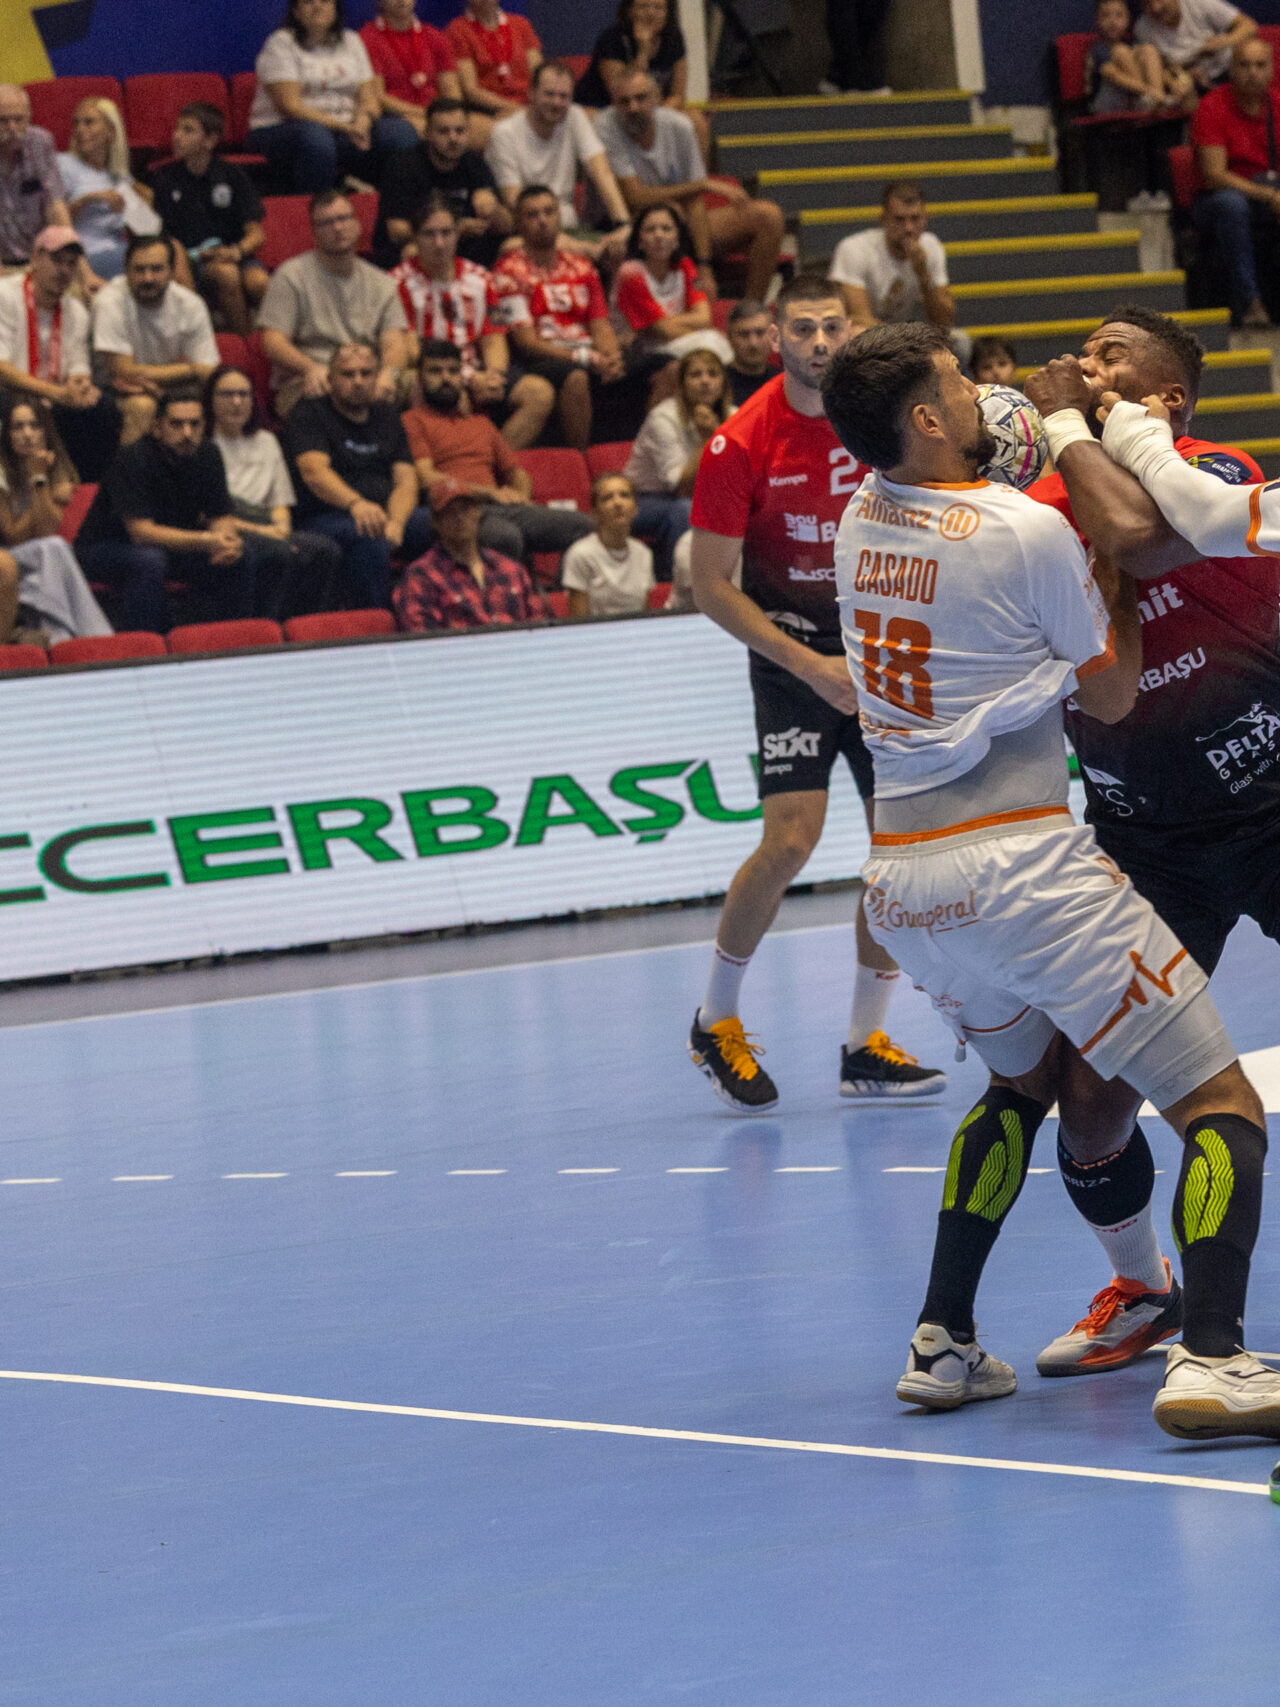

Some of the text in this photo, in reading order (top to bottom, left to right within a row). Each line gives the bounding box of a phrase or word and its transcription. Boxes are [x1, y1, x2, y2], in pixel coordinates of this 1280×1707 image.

[769, 473, 808, 487] Kempa
[828, 446, 859, 496] 2
[854, 548, 939, 605] CASADO
[853, 608, 936, 720] 18
[763, 727, 822, 761] SIXT
[1229, 773, 1254, 795] Glass
[1253, 758, 1274, 776] with
[887, 889, 978, 937] Guaperal
